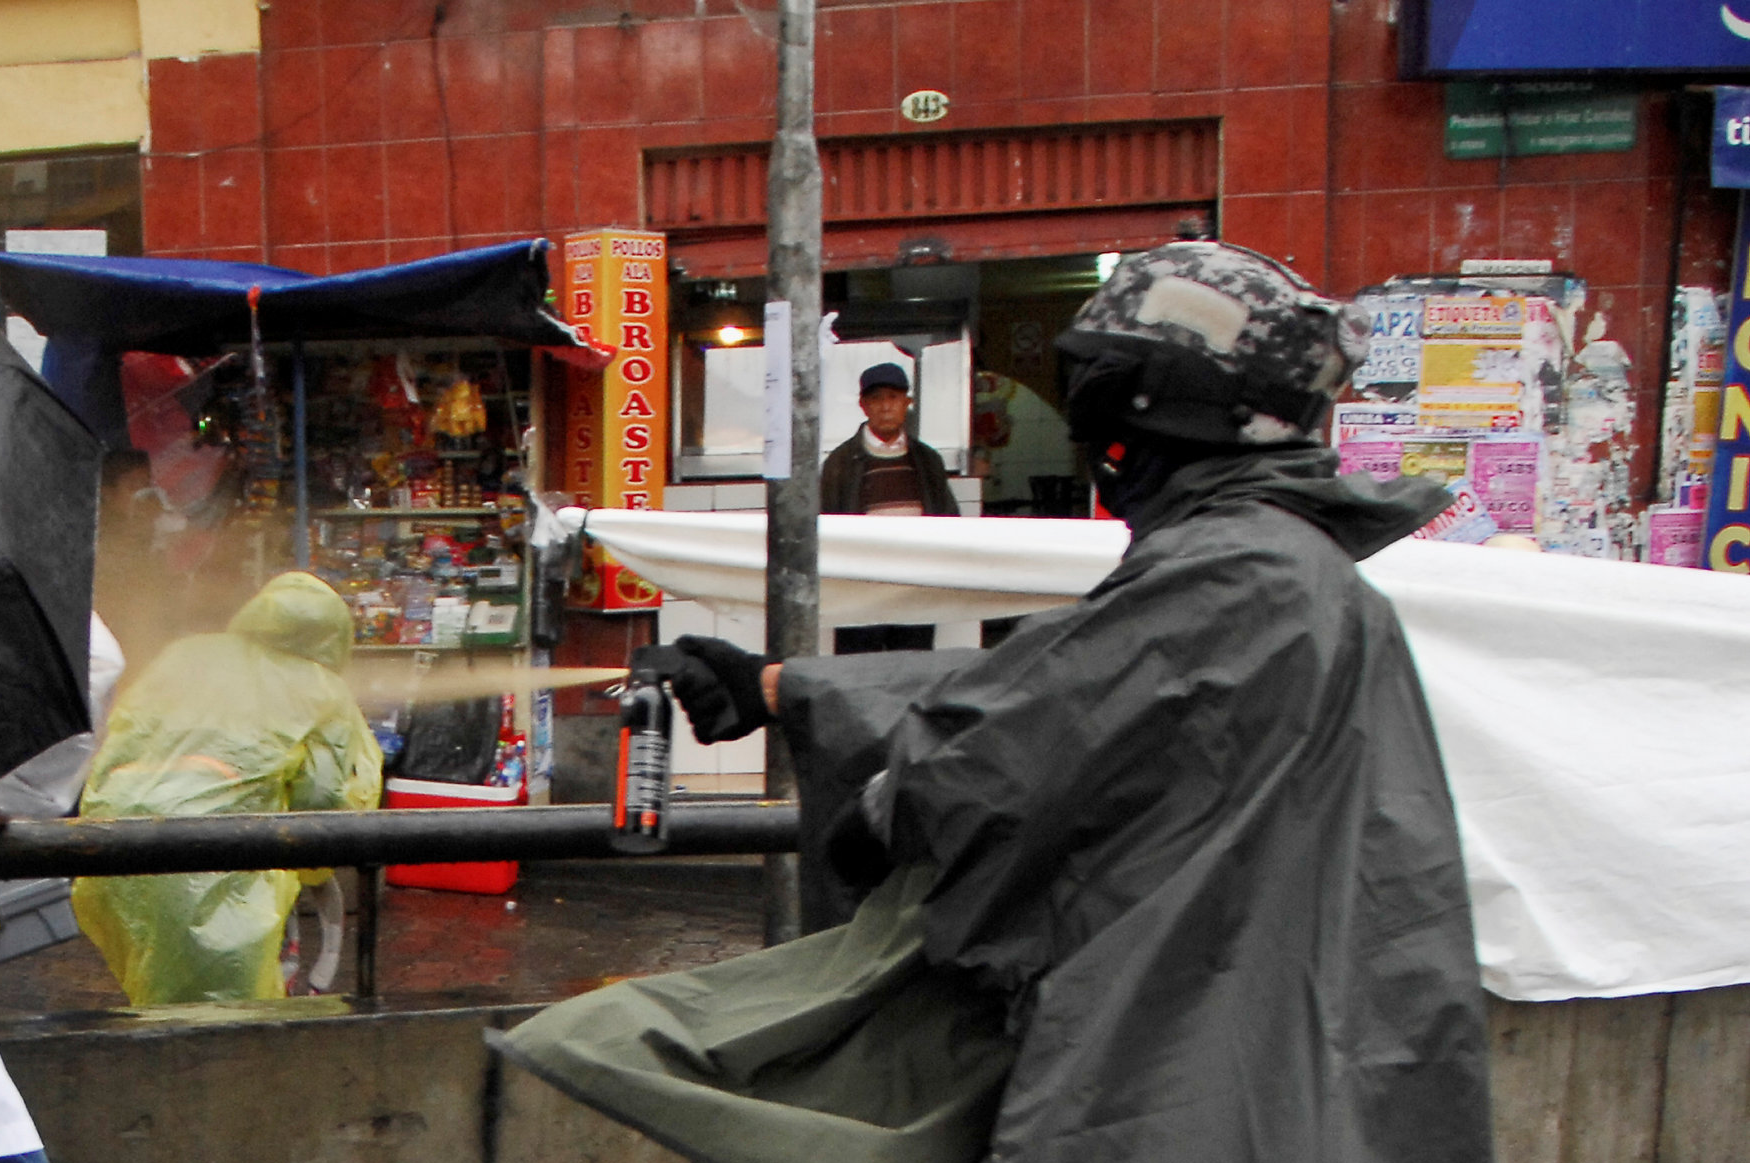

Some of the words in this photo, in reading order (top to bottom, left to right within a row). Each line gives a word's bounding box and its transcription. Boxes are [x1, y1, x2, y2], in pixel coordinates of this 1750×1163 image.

[911, 95, 940, 119] 843
[611, 238, 665, 260] POLLOS
[1428, 305, 1501, 323] ETIQUETA
